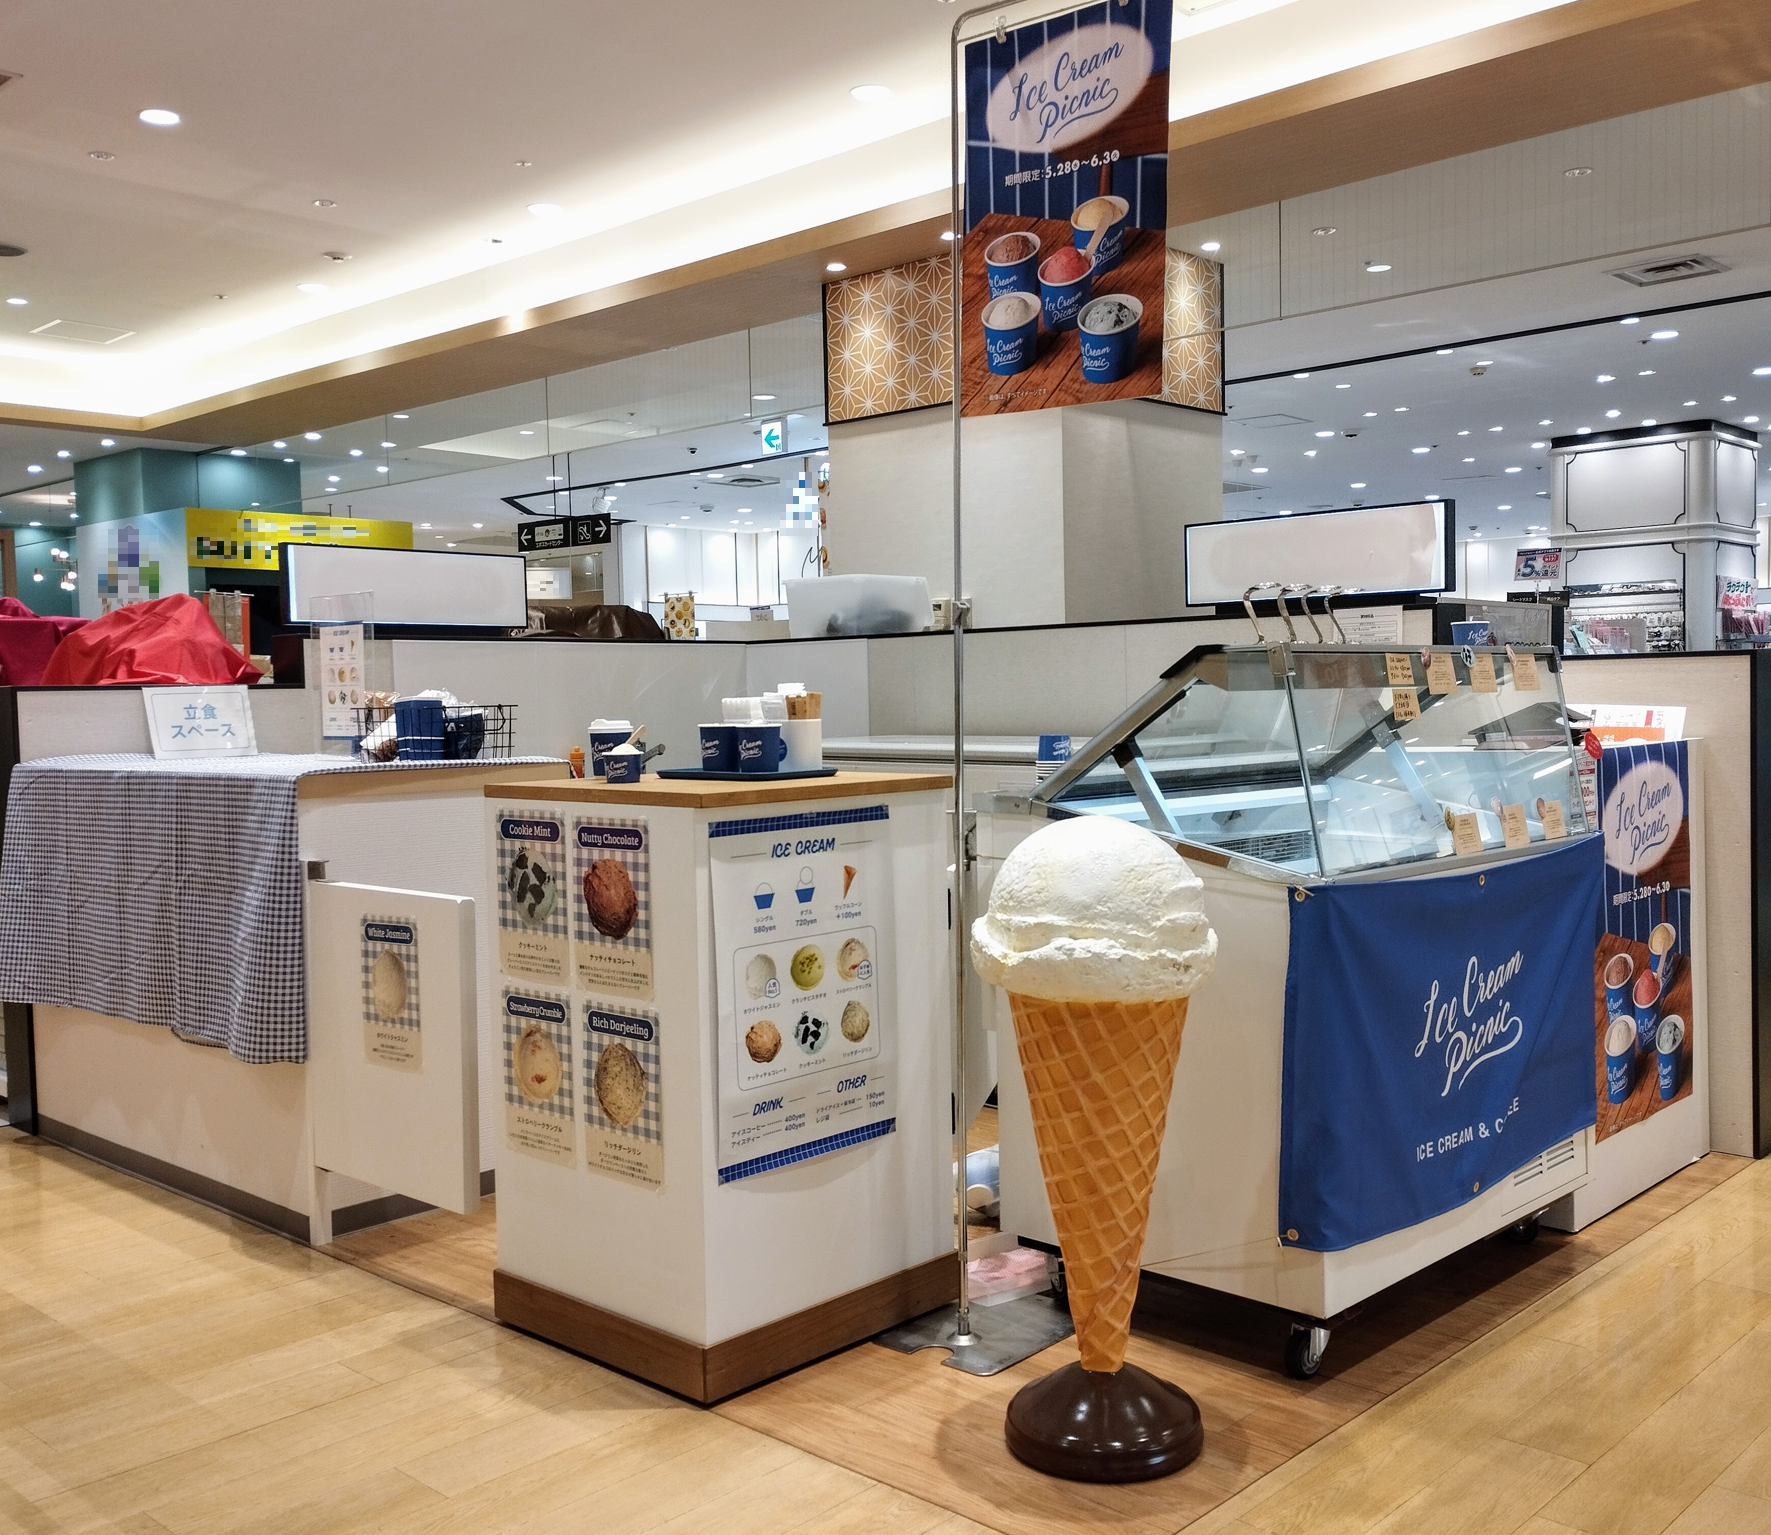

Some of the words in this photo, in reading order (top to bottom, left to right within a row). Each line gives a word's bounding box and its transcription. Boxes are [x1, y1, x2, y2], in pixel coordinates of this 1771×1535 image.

[1009, 72, 1049, 121] Ice
[1054, 42, 1125, 92] Cream
[1036, 77, 1119, 143] Picnic
[1045, 297, 1056, 312] Ice
[1057, 291, 1083, 309] Cream
[997, 338, 1024, 354] Cream
[1085, 343, 1112, 357] Cream
[992, 346, 1023, 367] Picnic
[183, 703, 218, 720] 立食
[171, 723, 236, 739] スペース
[594, 741, 615, 752] Cream
[741, 739, 763, 750] Cream
[1615, 792, 1636, 840] Ice
[1638, 780, 1672, 818] Cream
[509, 823, 534, 837] Cookie
[534, 825, 552, 838] Mint
[1630, 810, 1670, 865] Picnic
[581, 832, 602, 846] Nutty
[602, 834, 640, 847] Chocolate
[771, 842, 792, 859] ICE
[795, 837, 836, 856] CREAM
[755, 915, 774, 923] シングル
[795, 918, 818, 927] 720yen
[836, 910, 862, 920] +100yen
[367, 927, 386, 938] White
[386, 928, 411, 941] Jasmine
[518, 942, 548, 953] クッキーミント
[589, 954, 636, 967] ナッティチョコレート
[509, 1001, 540, 1017] Strawberry
[539, 1006, 563, 1019] Crumble
[743, 1002, 781, 1015] ホワイトジャスミン
[1414, 979, 1458, 1058] Ice
[1462, 949, 1524, 1018] Cream
[592, 1016, 609, 1030] Rich
[609, 1020, 650, 1039] Darjeeling
[1441, 999, 1523, 1097] Picnic
[746, 1067, 787, 1082] ナッティチョコレート
[837, 1074, 867, 1094] OTHER
[865, 1090, 885, 1101] 150yen
[752, 1096, 784, 1117] DRINK
[868, 1099, 885, 1109] 10yen
[517, 1116, 563, 1133] ストロベリークランブル
[731, 1123, 766, 1139] アイスコーヒー
[784, 1112, 806, 1123] 400yen
[731, 1135, 761, 1149] アイスティー
[784, 1121, 806, 1132] 400yen
[1416, 1141, 1434, 1163] ICE
[1437, 1125, 1474, 1155] CREAM
[1478, 1122, 1490, 1138] &
[604, 1140, 642, 1156] リッチダージリン
